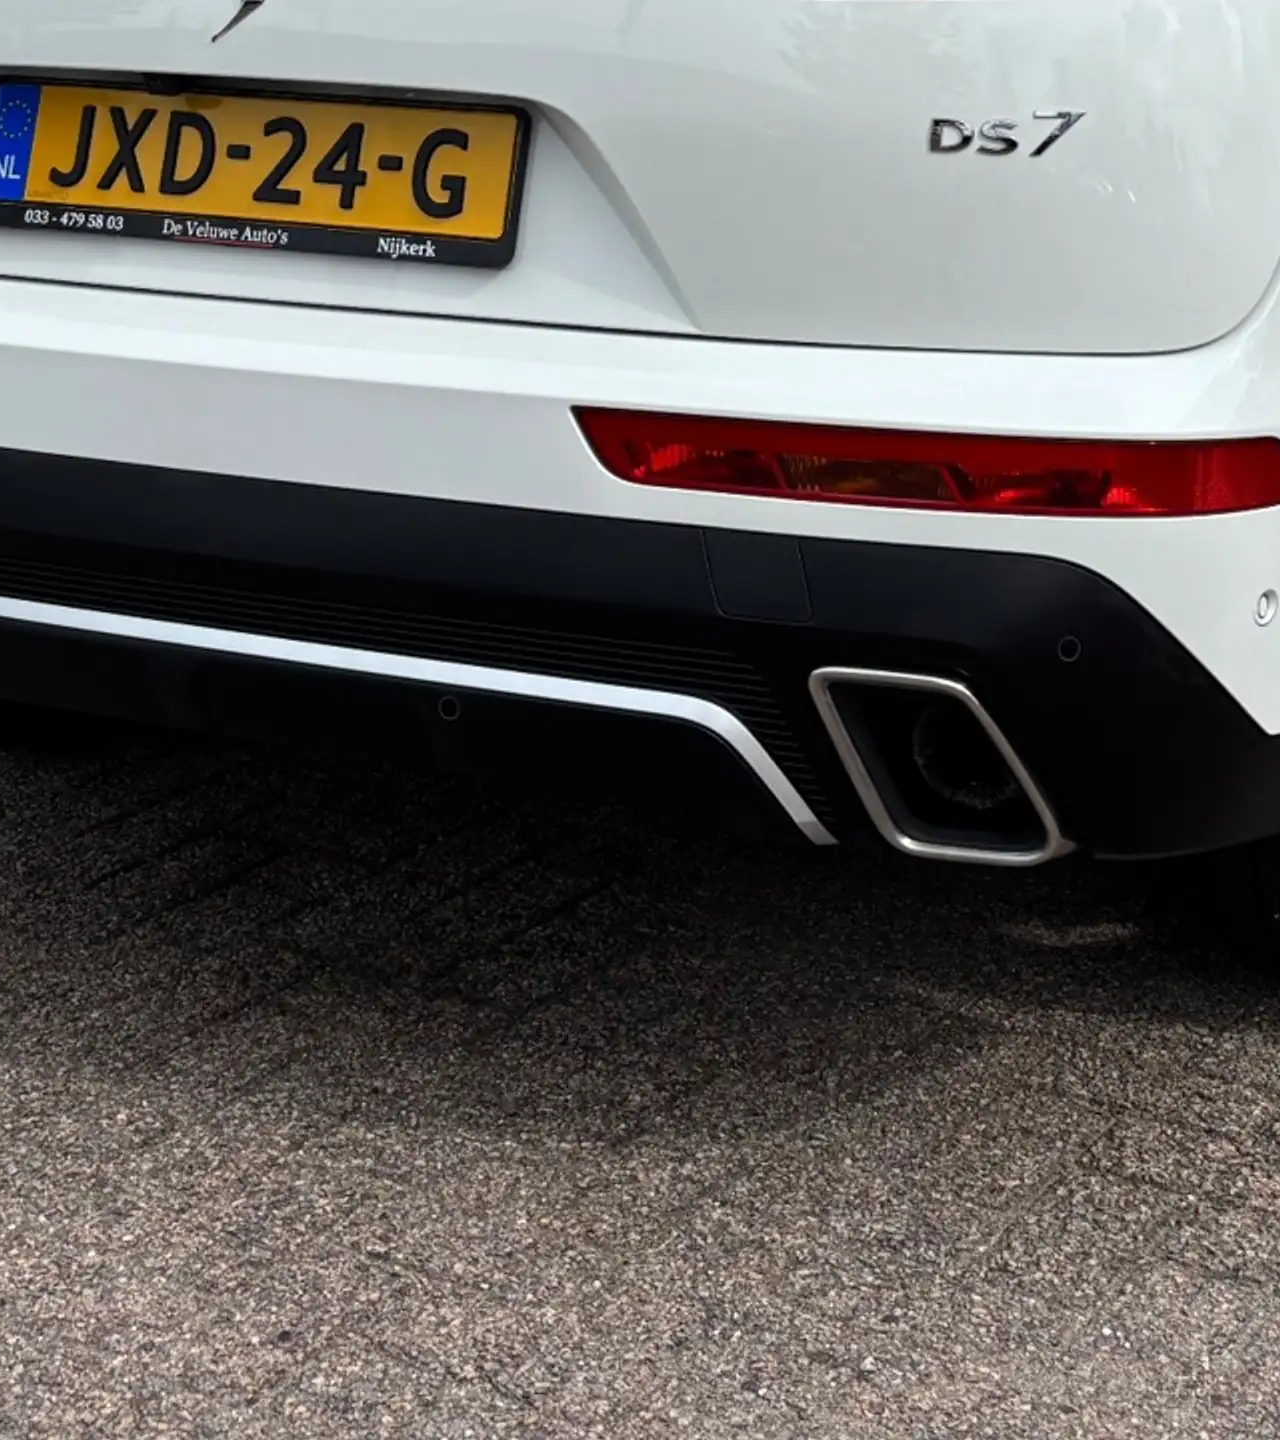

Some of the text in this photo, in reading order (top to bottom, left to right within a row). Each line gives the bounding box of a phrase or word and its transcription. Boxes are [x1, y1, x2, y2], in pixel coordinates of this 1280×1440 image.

[48, 104, 470, 220] JXD-24-G
[24, 208, 50, 225] 033
[59, 212, 85, 228] 479
[87, 213, 104, 230] 58
[106, 215, 125, 232] 03
[162, 219, 289, 246] De Veluwe Auto's
[377, 237, 437, 259] Nijkerk
